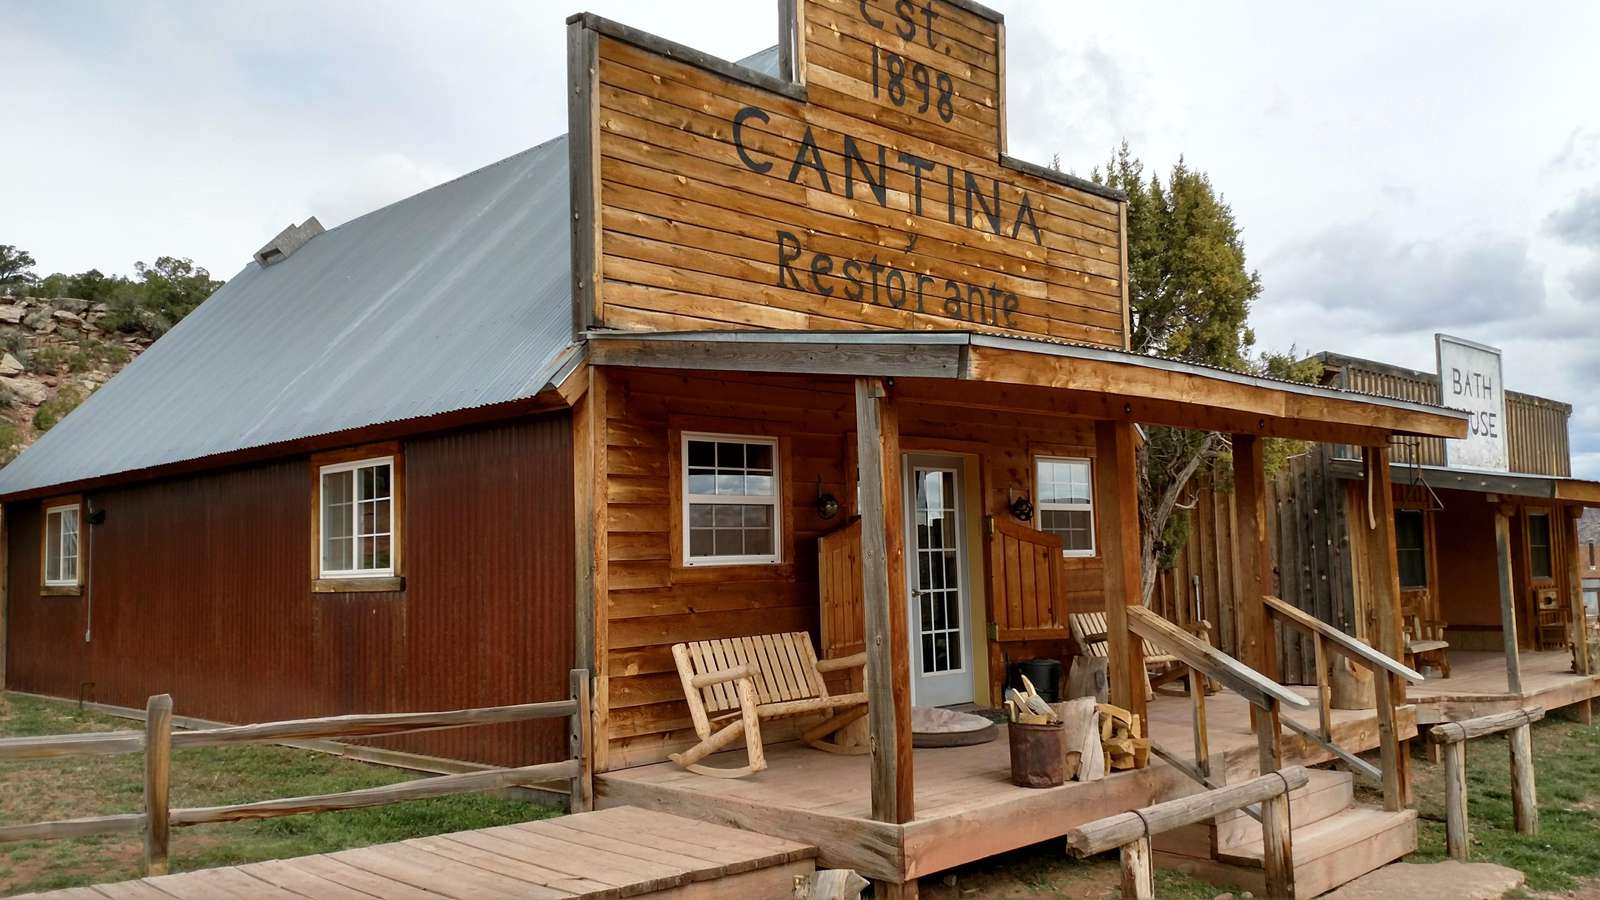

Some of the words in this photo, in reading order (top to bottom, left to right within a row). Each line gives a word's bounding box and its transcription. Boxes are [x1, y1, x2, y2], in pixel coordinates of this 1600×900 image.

[872, 46, 953, 123] 1898
[732, 107, 1042, 246] CANTINA
[776, 230, 1020, 328] Restorante
[1452, 367, 1492, 401] BATH
[1468, 409, 1498, 438] USE
